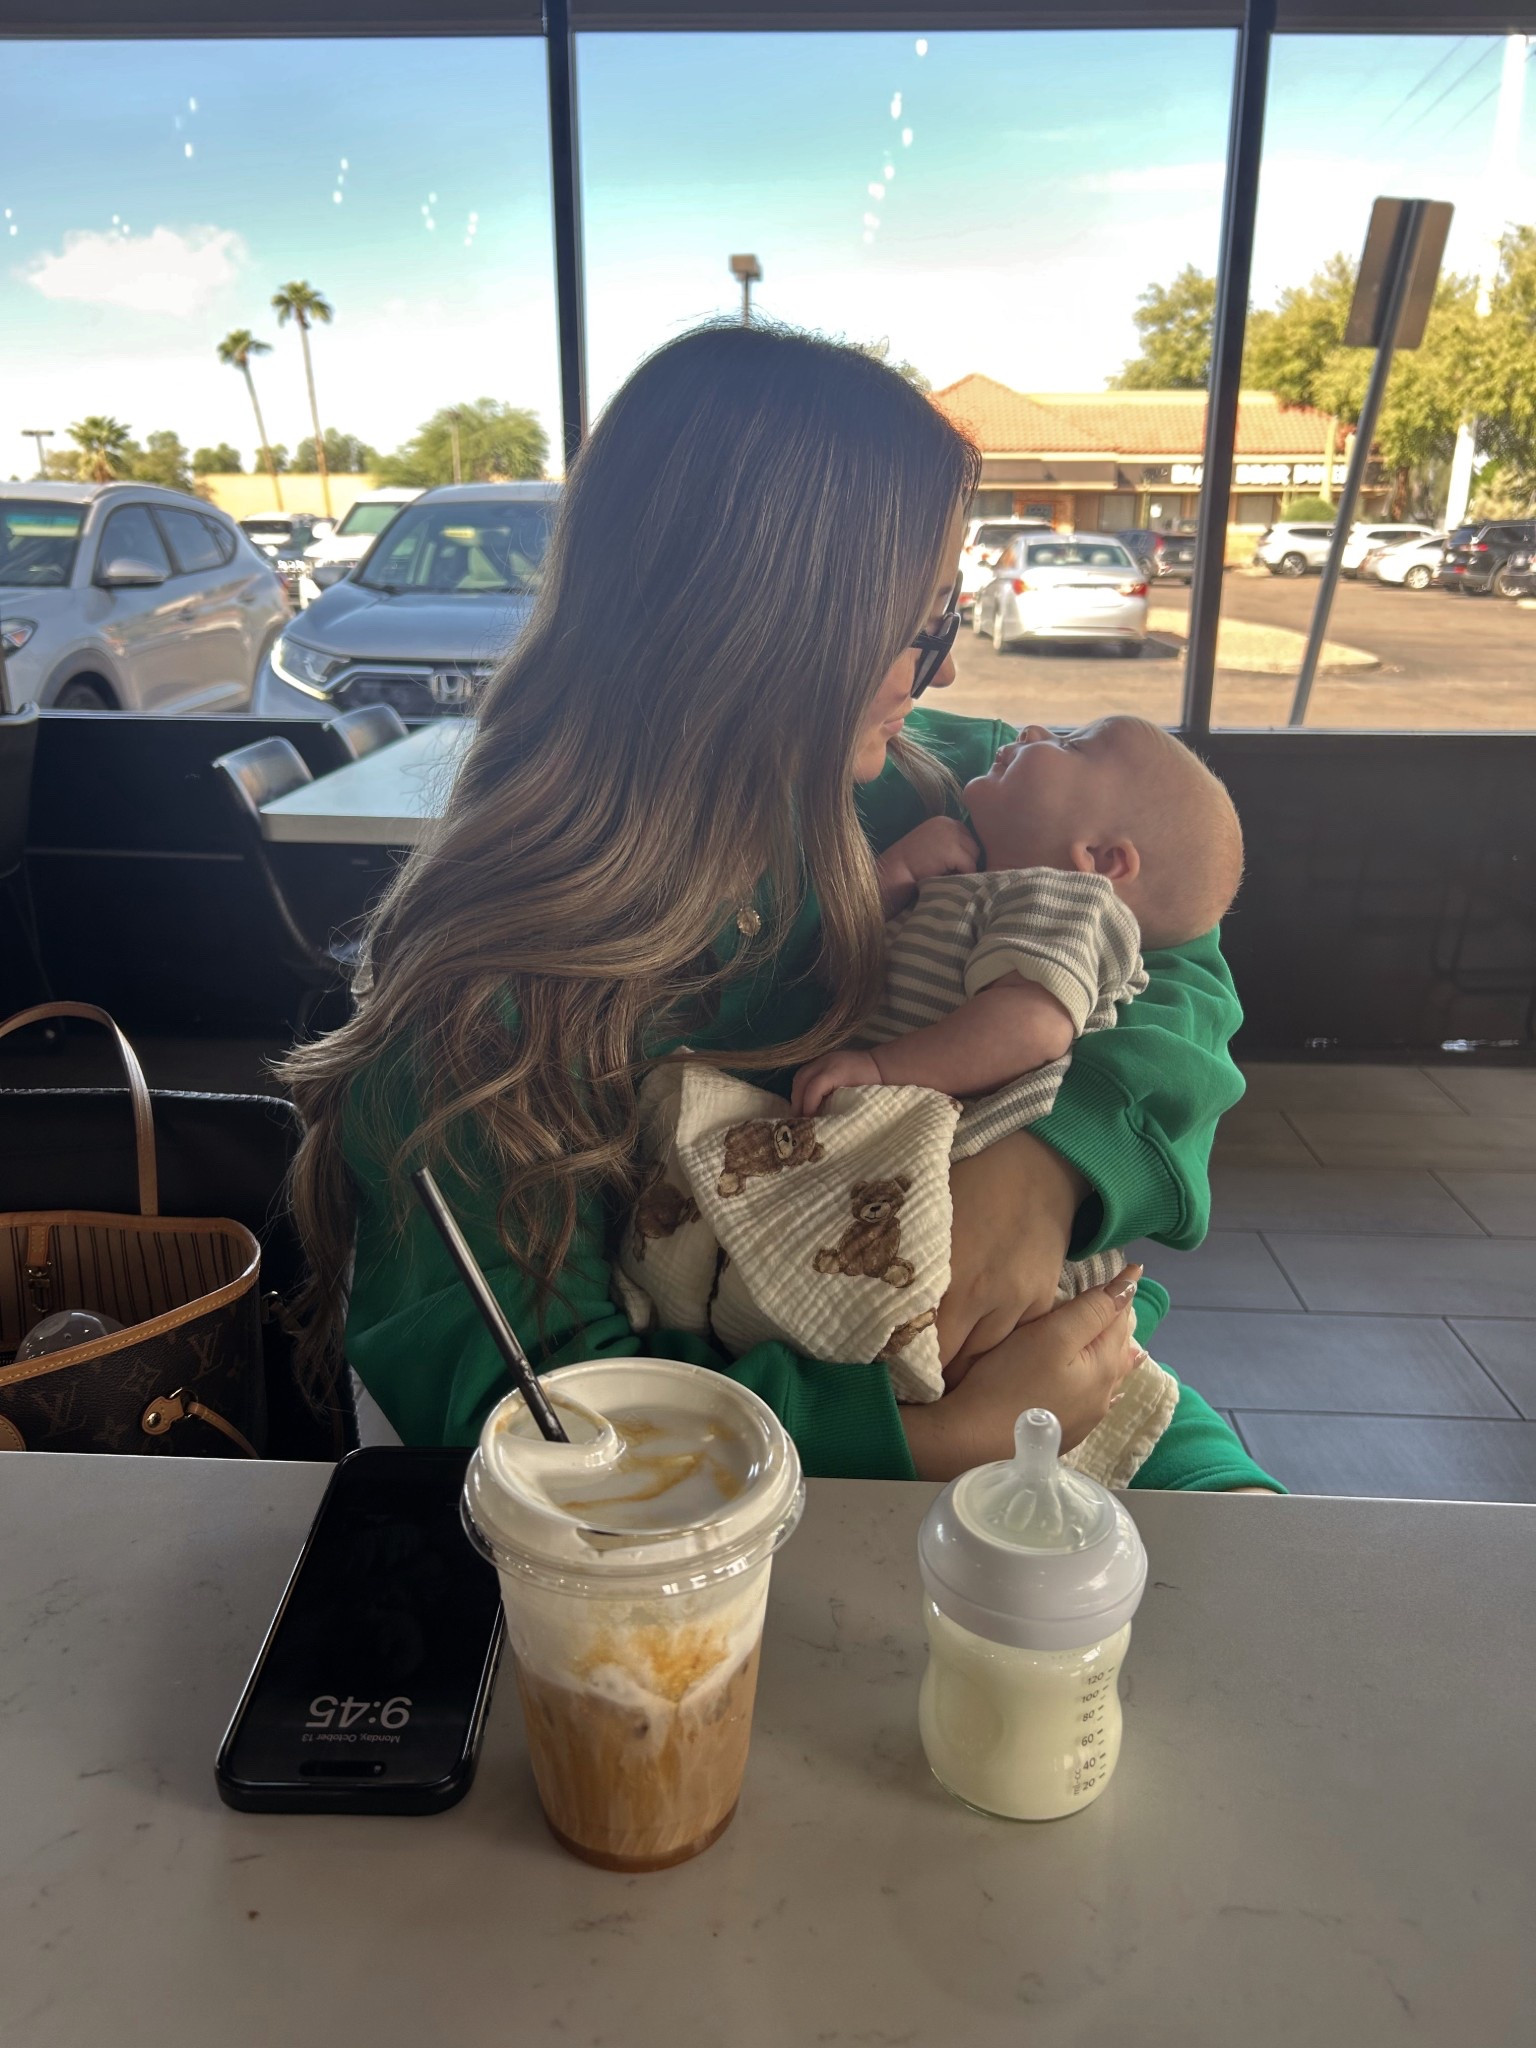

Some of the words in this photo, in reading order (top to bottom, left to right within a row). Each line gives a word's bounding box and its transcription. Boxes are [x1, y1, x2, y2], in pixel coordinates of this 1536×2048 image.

[1088, 1672, 1104, 1685] 120
[1082, 1690, 1100, 1703] 100
[305, 1695, 413, 1729] 9:45
[1082, 1710, 1095, 1722] 80
[302, 1733, 313, 1742] 13
[316, 1733, 357, 1743] October
[360, 1733, 400, 1743] Monday,
[1081, 1733, 1094, 1747] 60
[1083, 1757, 1096, 1770] 40
[1083, 1778, 1096, 1791] 20
